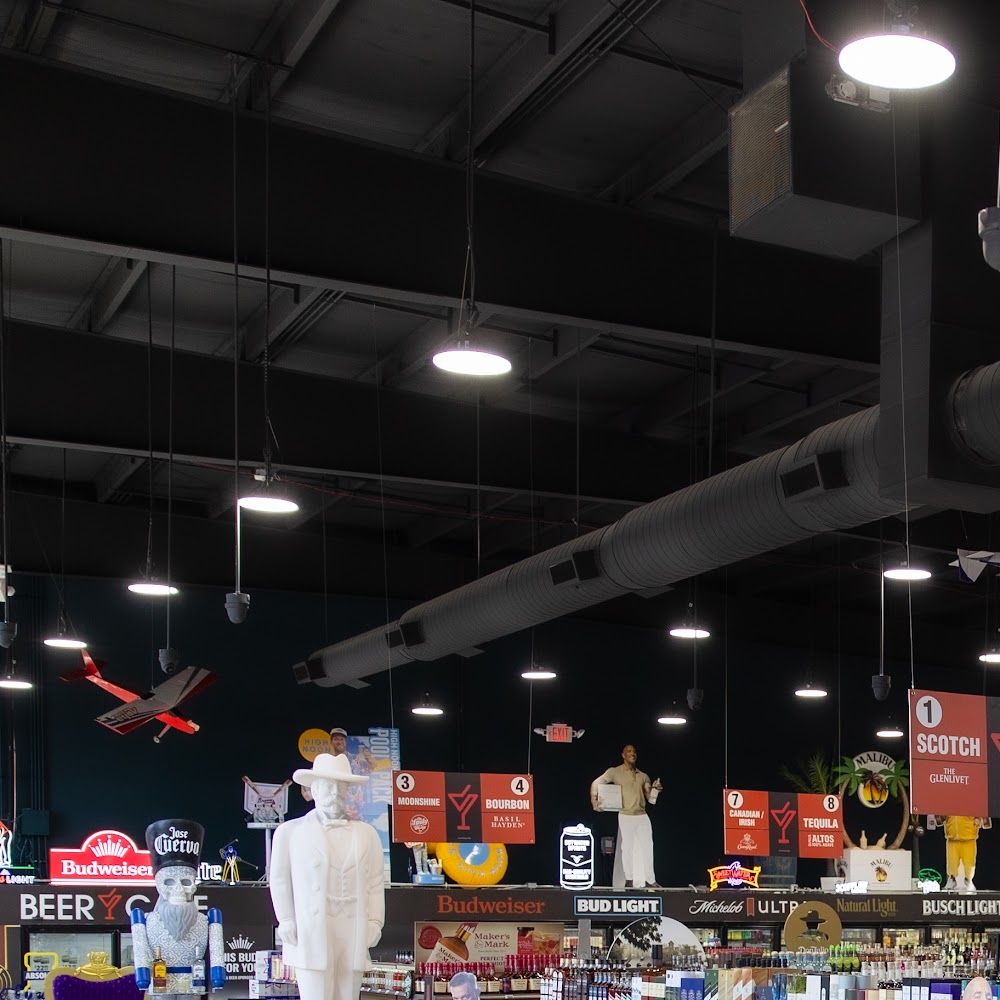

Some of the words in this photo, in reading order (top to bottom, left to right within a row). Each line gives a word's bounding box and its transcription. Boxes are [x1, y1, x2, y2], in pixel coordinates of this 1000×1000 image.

[923, 700, 932, 723] 1
[552, 728, 570, 740] EXIT
[917, 733, 980, 757] SCOTCH
[856, 753, 895, 770] MALIBU
[401, 776, 409, 789] 3
[930, 774, 969, 785] GLENLIVET
[516, 780, 524, 792] 4
[398, 797, 440, 806] MOONSHINE
[486, 799, 529, 810] BOURBON
[732, 794, 738, 806] 7
[828, 797, 834, 809] 8
[730, 810, 760, 818] CANADIAN
[803, 818, 838, 828] TEQUILA
[169, 827, 188, 839] Jose
[154, 834, 199, 856] Cuervo
[61, 860, 153, 876] Budweiser
[870, 859, 893, 868] MALIBU
[6, 875, 35, 884] LIGHT
[20, 894, 94, 920] BEER
[438, 895, 545, 913] Budweiser
[578, 900, 611, 912] BUD
[613, 900, 659, 912] LIGHT
[689, 900, 744, 914] Michelob
[758, 901, 806, 914] ULTR
[837, 898, 871, 913] Natural
[872, 900, 896, 917] Light
[923, 900, 967, 916] BUSCH
